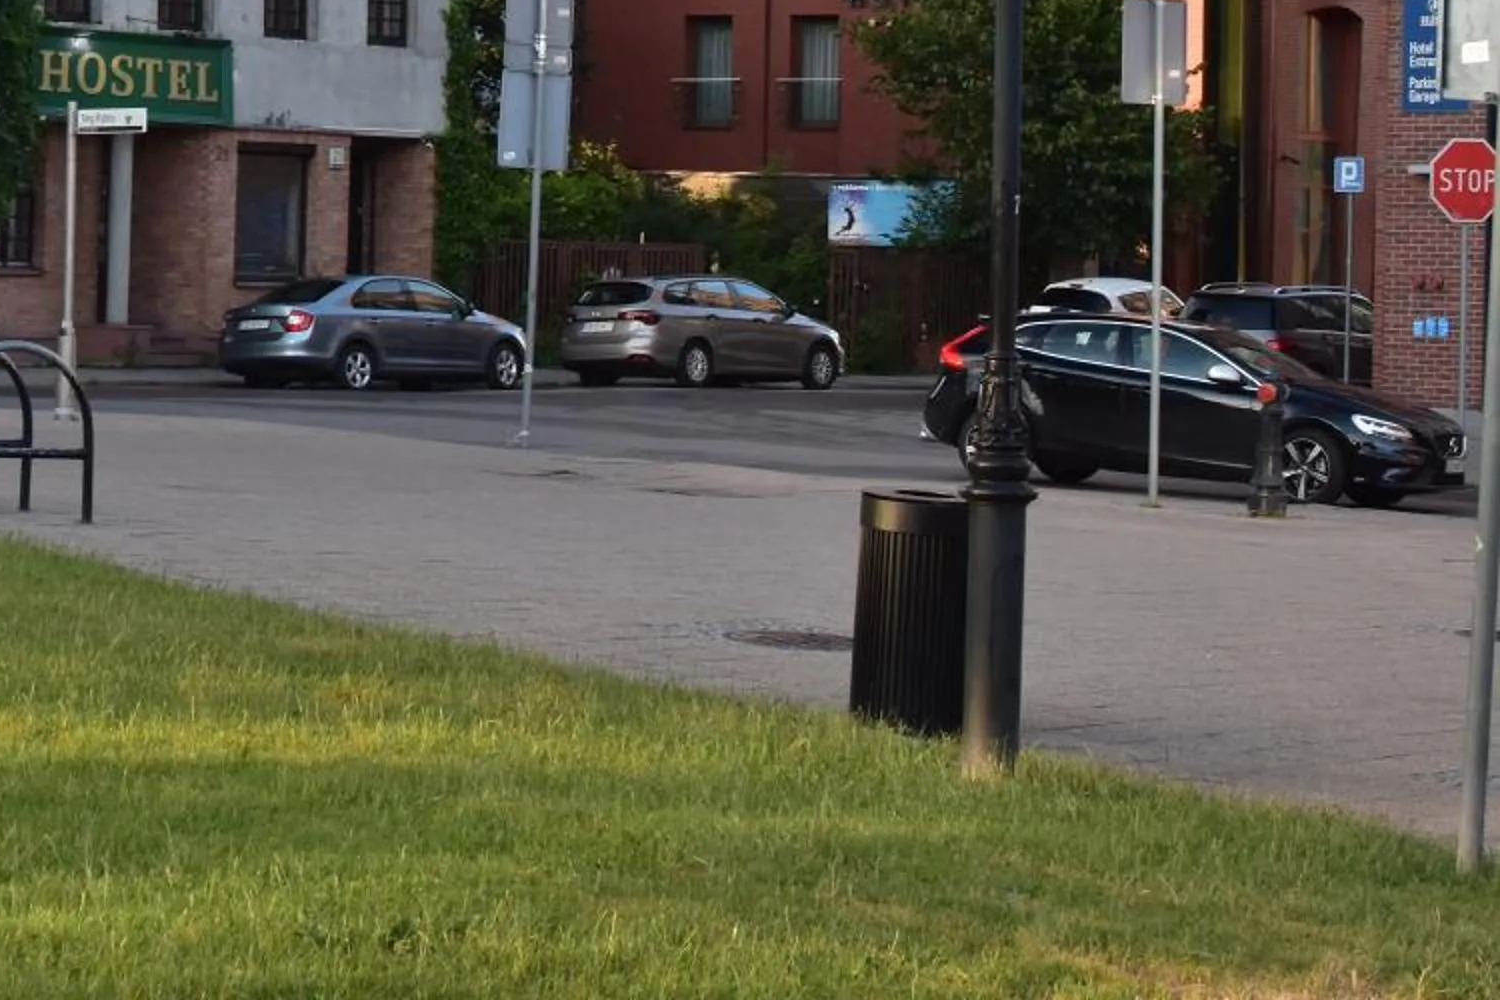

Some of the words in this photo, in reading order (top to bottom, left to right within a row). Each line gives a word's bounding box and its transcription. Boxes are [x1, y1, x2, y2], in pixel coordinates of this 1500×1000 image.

[1409, 41, 1434, 55] Hotel
[40, 50, 219, 102] HOSTEL
[1439, 168, 1496, 193] STOP
